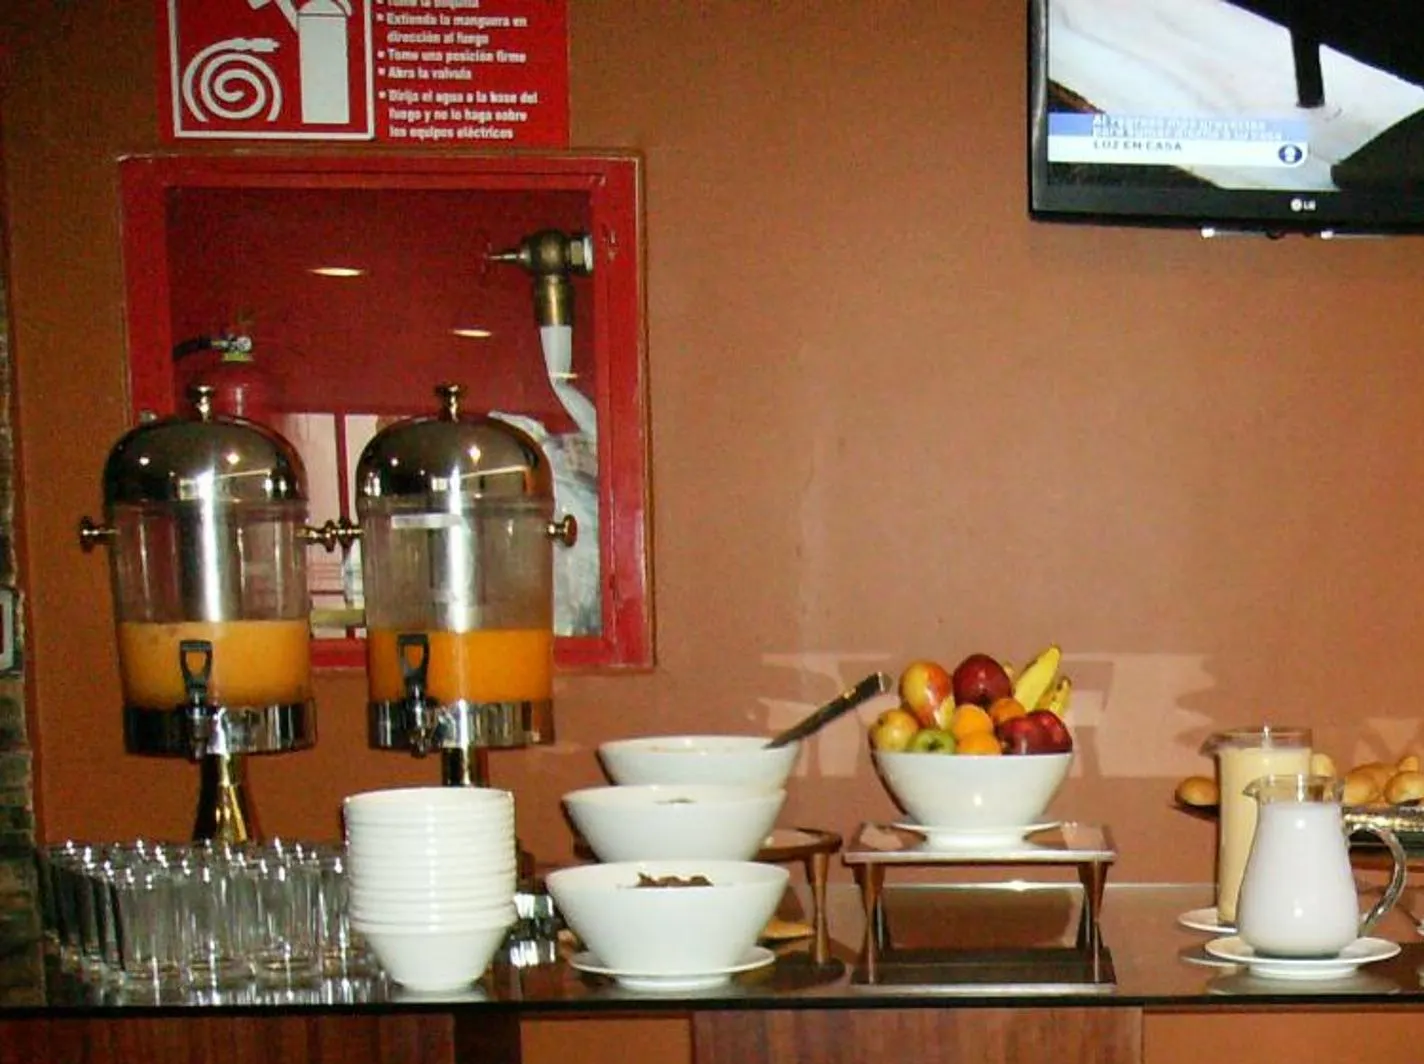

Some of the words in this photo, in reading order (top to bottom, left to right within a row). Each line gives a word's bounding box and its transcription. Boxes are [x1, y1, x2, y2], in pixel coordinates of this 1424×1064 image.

[387, 13, 437, 25] Extienda
[440, 14, 450, 25] la
[453, 16, 509, 29] manguera
[513, 17, 526, 27] en
[457, 32, 489, 47] fuego
[422, 52, 443, 61] una
[497, 50, 527, 62] firme
[389, 66, 416, 78] Abra
[418, 67, 429, 78] la
[422, 91, 432, 102] el
[436, 93, 463, 106] agua
[476, 91, 487, 103] la
[490, 91, 517, 103] base
[520, 92, 538, 104] del
[389, 108, 421, 122] fuego
[424, 111, 431, 123] y
[434, 111, 448, 120] no
[451, 109, 462, 120] lo
[464, 109, 492, 123] haga
[495, 109, 528, 122] sobre
[390, 126, 406, 138] los
[410, 126, 454, 140] equipos
[1094, 141, 1119, 150] LUZ
[1123, 141, 1142, 150] EN
[1146, 141, 1182, 151] CASA
